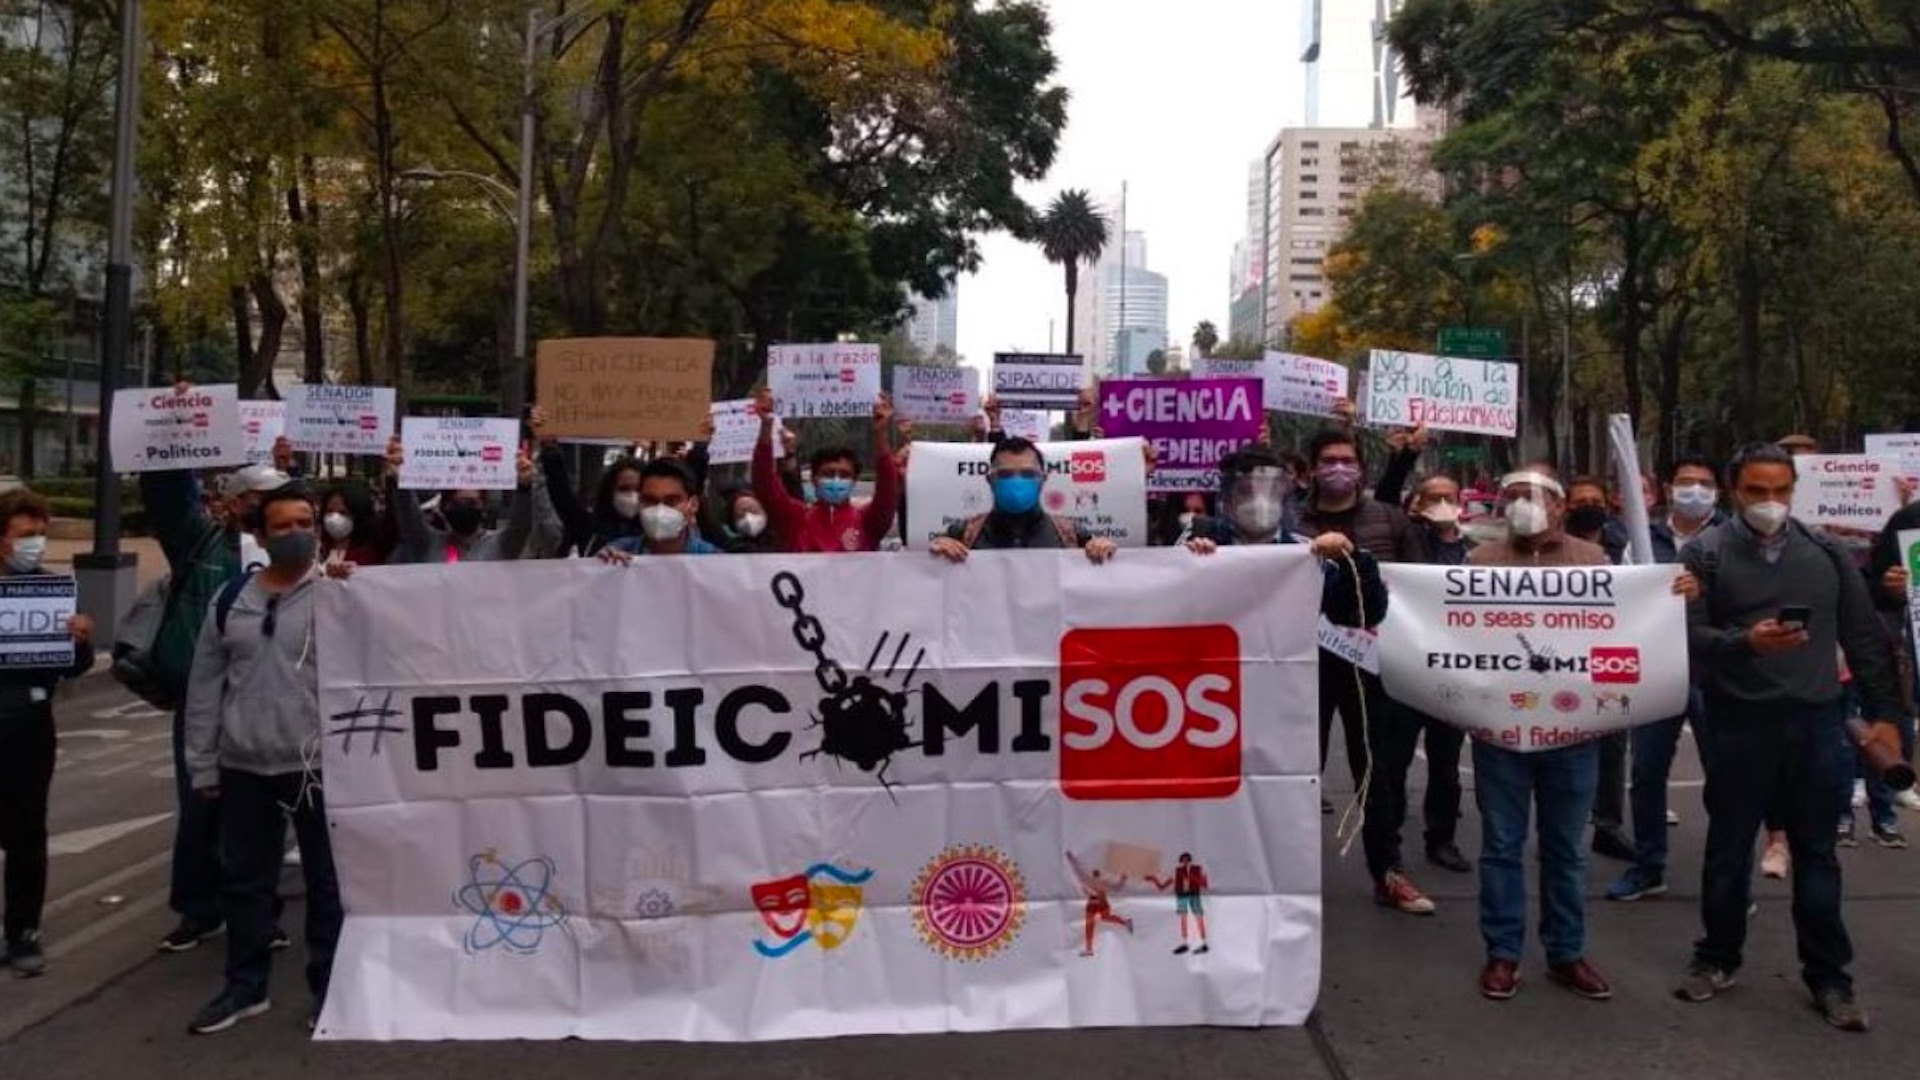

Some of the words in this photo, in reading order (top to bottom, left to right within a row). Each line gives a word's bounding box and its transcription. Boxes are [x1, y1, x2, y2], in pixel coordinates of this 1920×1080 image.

[1375, 350, 1408, 374] NO
[1436, 357, 1452, 379] a
[1484, 362, 1508, 383] la
[152, 393, 213, 410] Ciencia
[802, 399, 814, 414] la
[1824, 459, 1880, 473] Ciencia
[1445, 568, 1613, 597] SENADOR
[1446, 609, 1476, 627] no
[1483, 609, 1535, 629] seas
[1543, 608, 1616, 630] omiso
[1426, 651, 1639, 675] FIDEICMISOS
[328, 673, 1238, 772] #FIDEICMISOS
